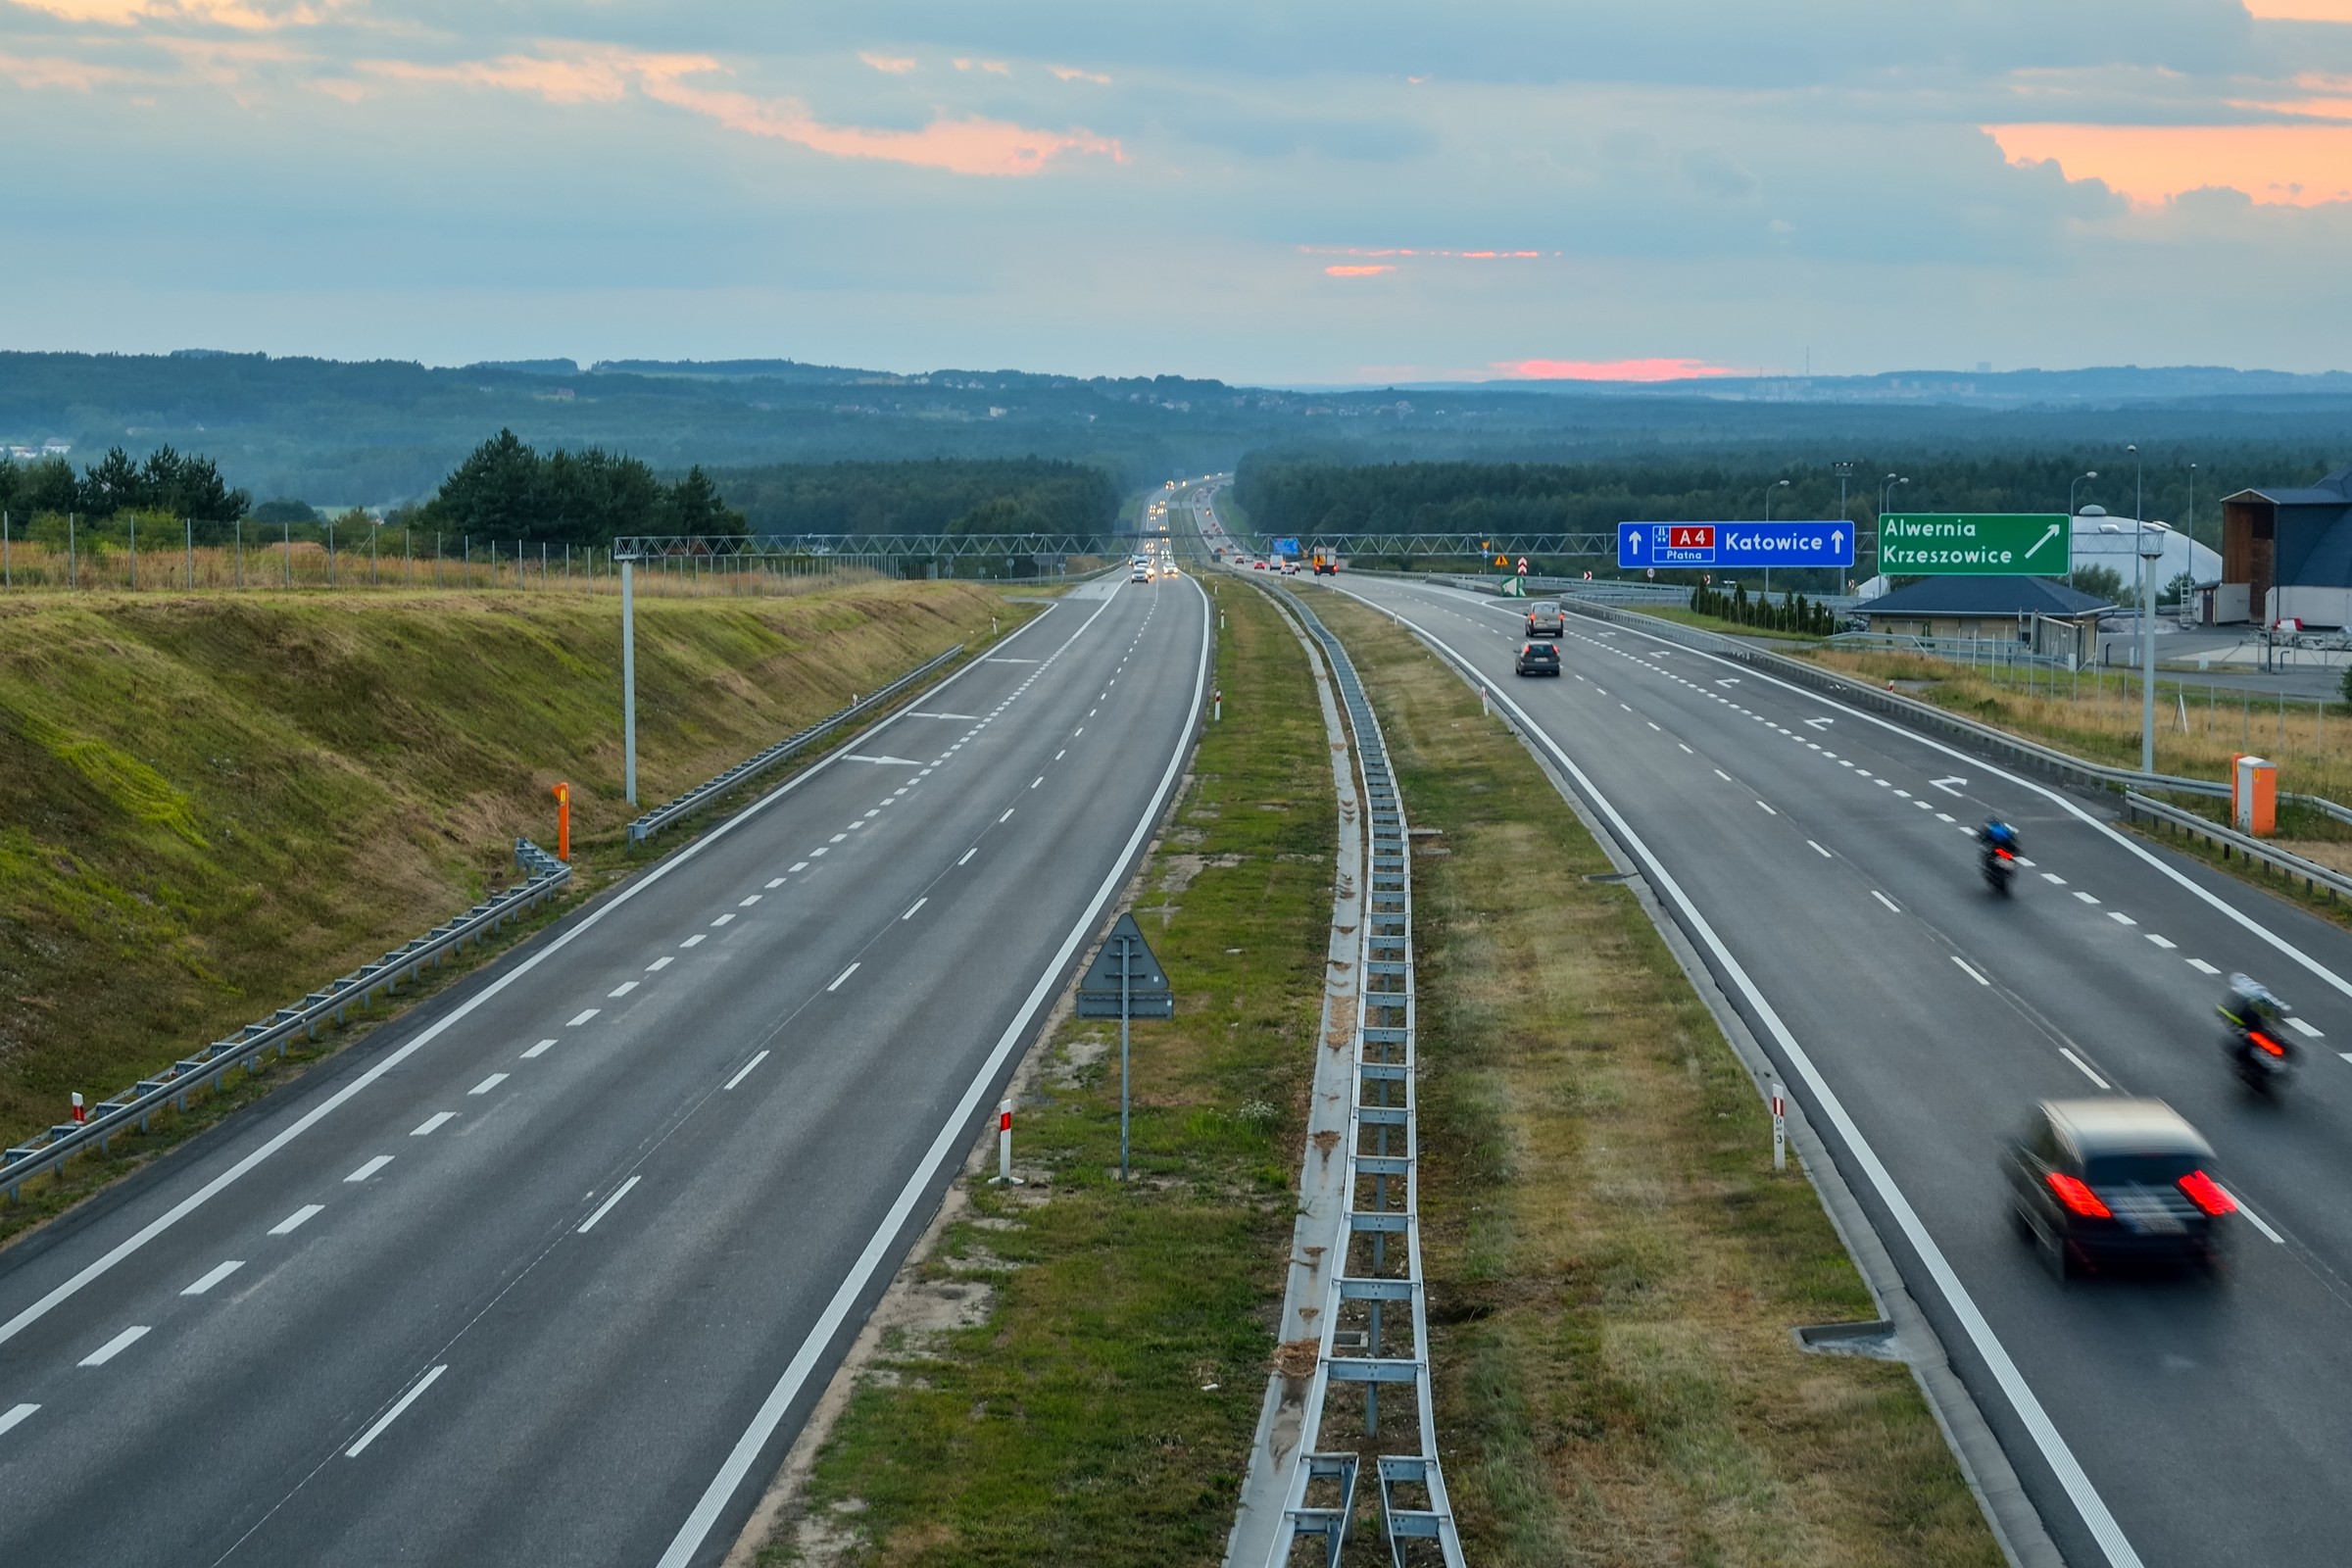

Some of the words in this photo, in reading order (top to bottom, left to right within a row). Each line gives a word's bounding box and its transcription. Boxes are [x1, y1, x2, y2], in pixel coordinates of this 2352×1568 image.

[1885, 518, 1976, 536] Alwernia
[1726, 532, 1823, 551] Katowice
[1667, 550, 1701, 560] Płatna
[1884, 545, 2012, 564] Krzeszowice
